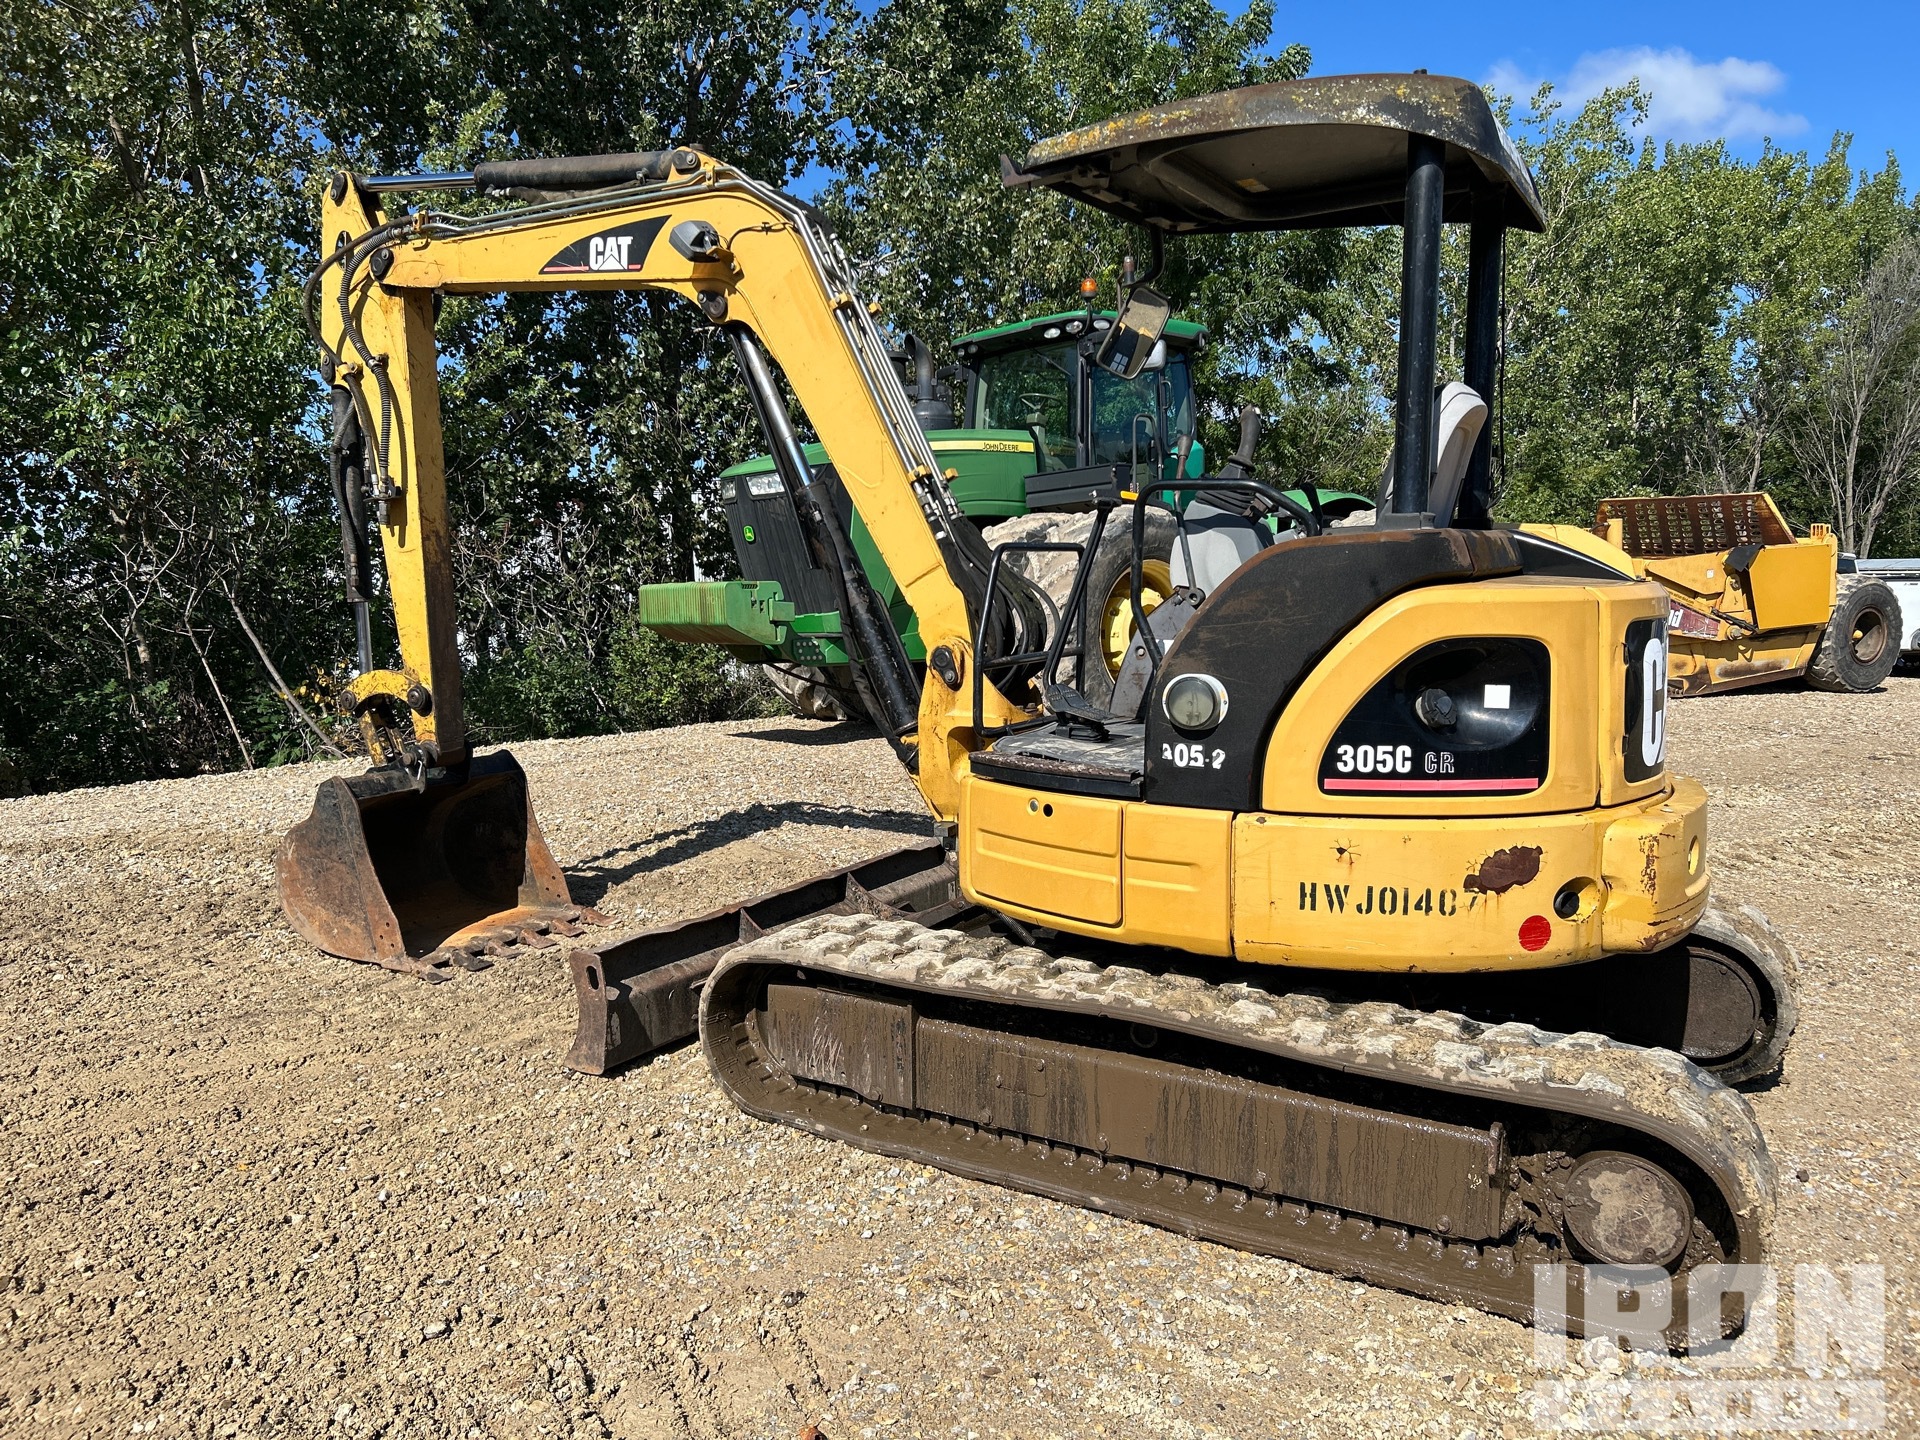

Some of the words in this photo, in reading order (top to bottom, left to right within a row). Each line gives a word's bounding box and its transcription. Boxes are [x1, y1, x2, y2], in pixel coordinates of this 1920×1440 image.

[589, 236, 634, 271] CAT
[982, 442, 999, 451] JOHN
[1000, 443, 1020, 452] DEERE
[1336, 744, 1412, 774] 305C
[1424, 751, 1455, 774] CR
